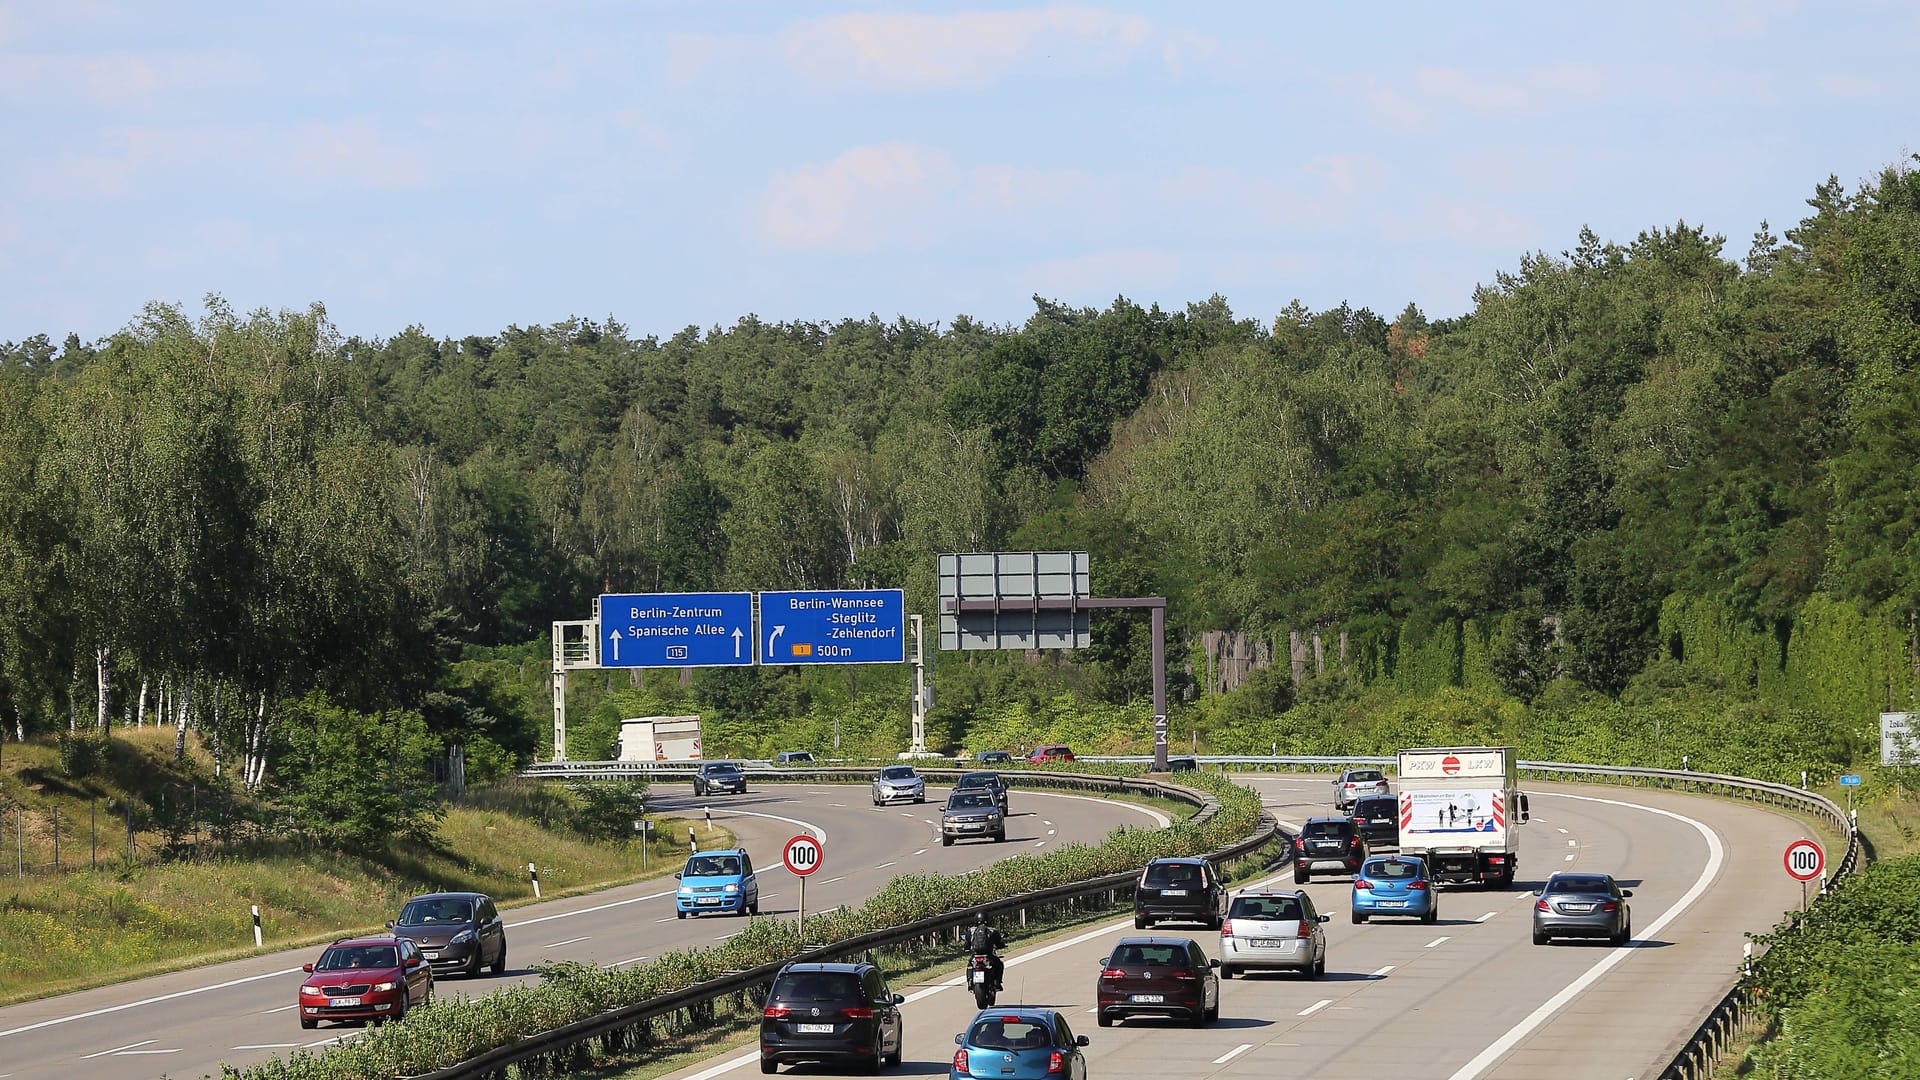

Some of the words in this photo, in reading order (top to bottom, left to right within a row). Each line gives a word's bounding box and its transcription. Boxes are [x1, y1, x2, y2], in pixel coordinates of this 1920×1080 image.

[790, 598, 884, 610] Berlin-Wannsee
[630, 606, 722, 619] Berlin-Zentrum
[826, 612, 876, 626] -Steglitz
[628, 625, 689, 639] Spanische
[694, 624, 726, 635] Allee
[826, 627, 896, 639] -Zehlendorf
[670, 648, 683, 657] 115
[817, 645, 839, 657] 500
[840, 647, 852, 657] m
[1408, 760, 1436, 771] PKW
[1467, 759, 1495, 770] LKW
[791, 846, 815, 865] 100
[1792, 851, 1816, 870] 100
